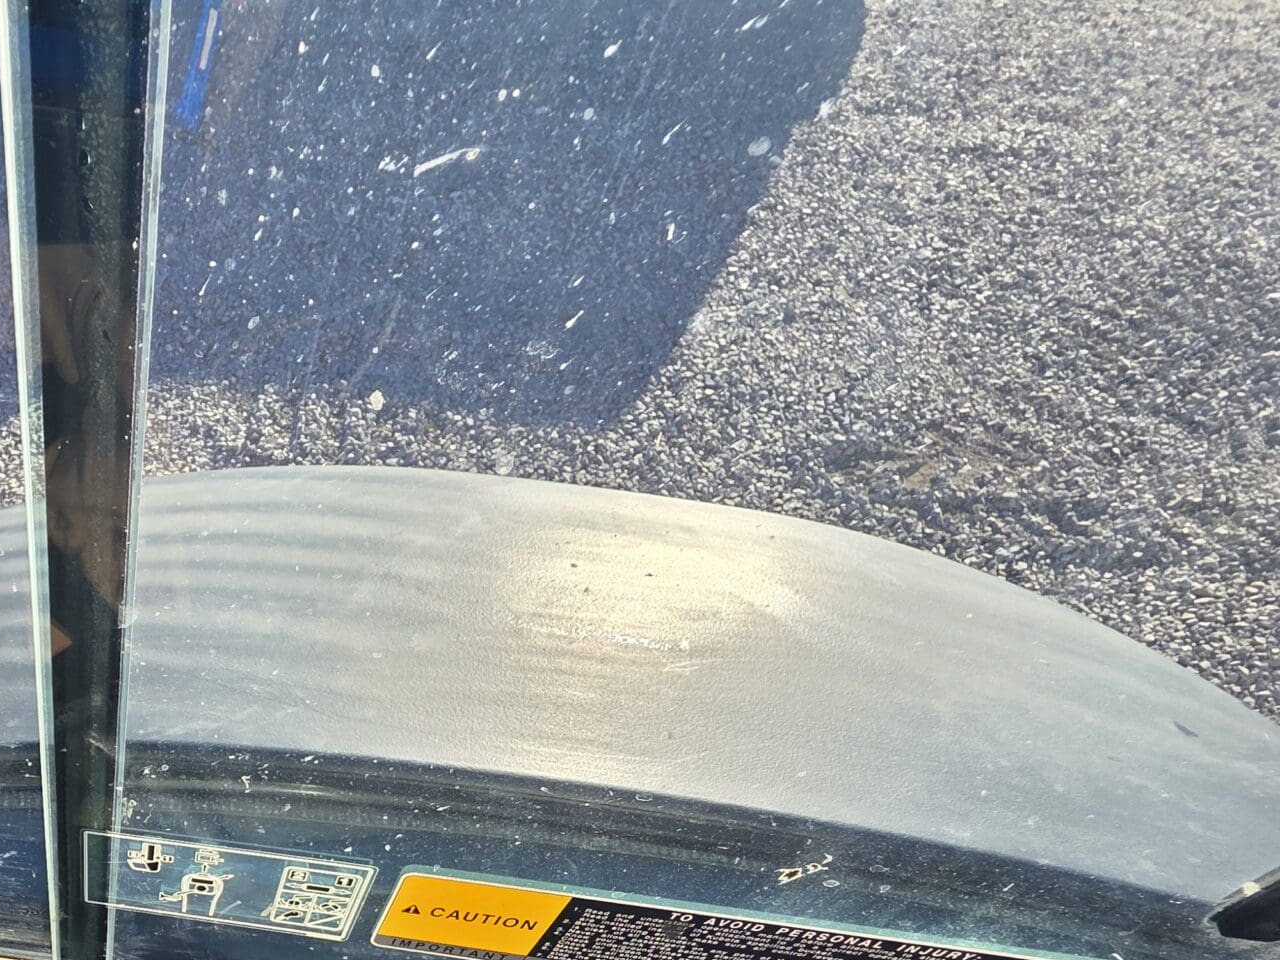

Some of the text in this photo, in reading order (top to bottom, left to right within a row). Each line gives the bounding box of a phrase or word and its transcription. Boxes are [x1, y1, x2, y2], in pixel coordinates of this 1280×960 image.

[429, 906, 539, 931] CAUTION
[670, 912, 693, 922] TO
[704, 918, 764, 932] AVOID
[776, 928, 882, 948] PERSONAL
